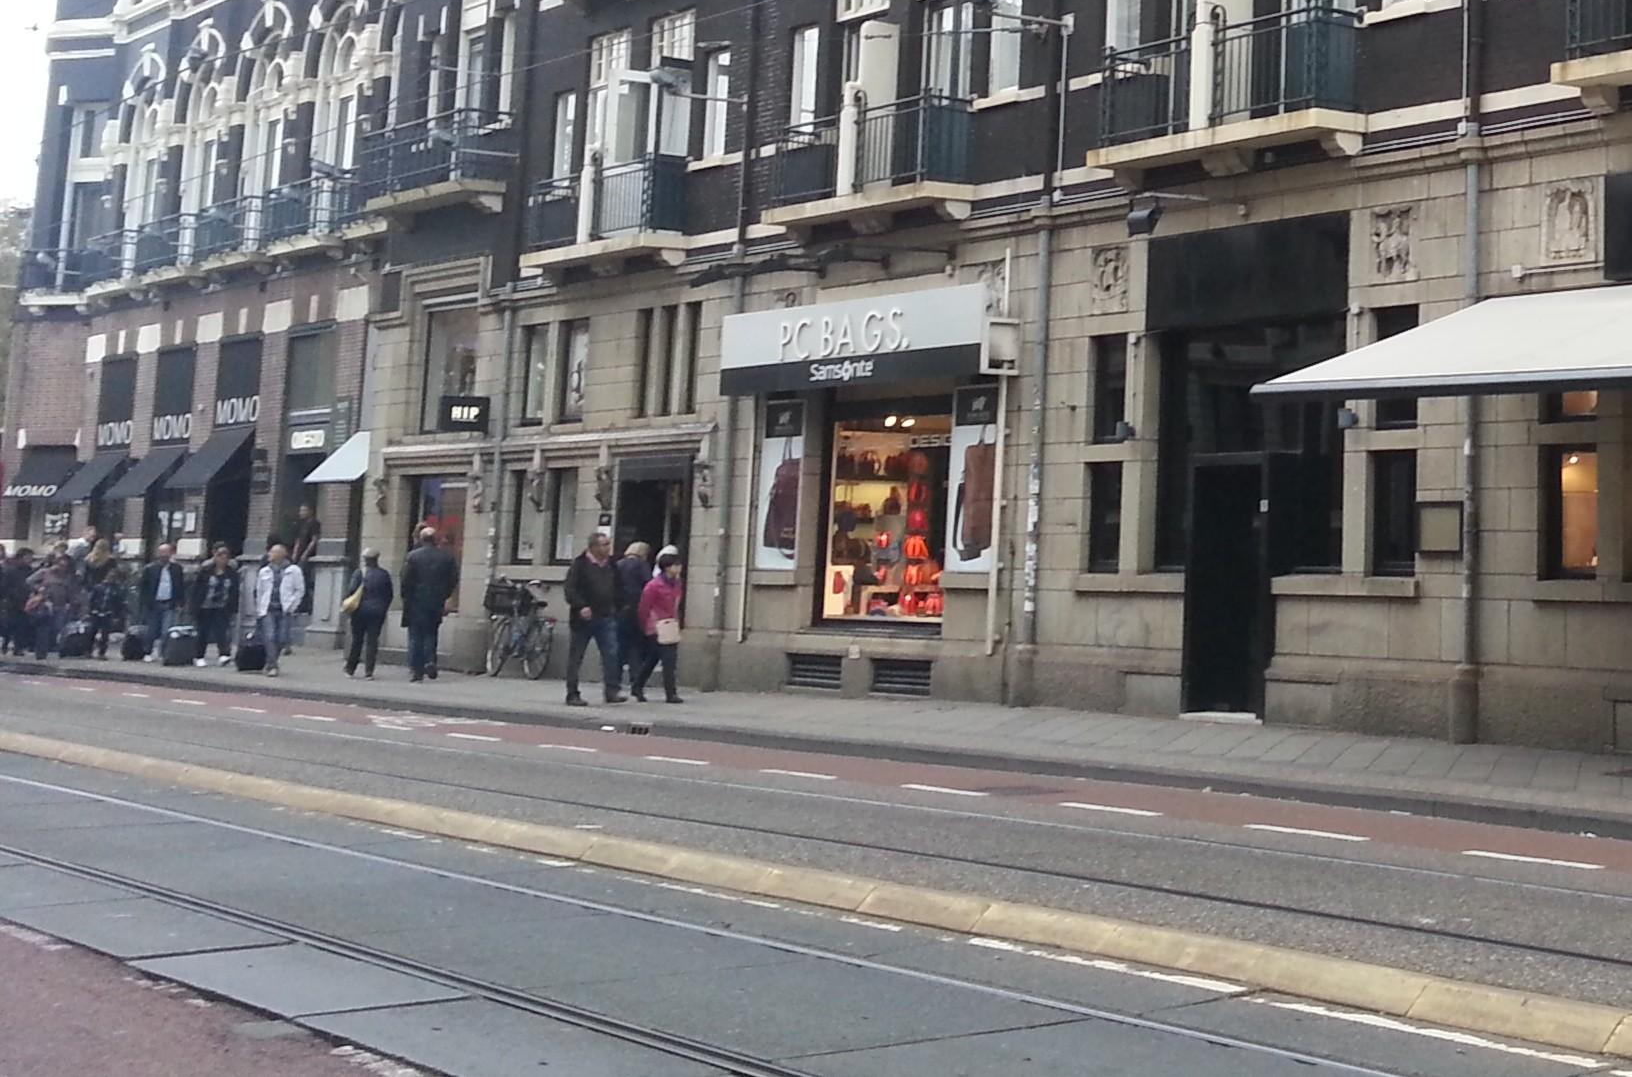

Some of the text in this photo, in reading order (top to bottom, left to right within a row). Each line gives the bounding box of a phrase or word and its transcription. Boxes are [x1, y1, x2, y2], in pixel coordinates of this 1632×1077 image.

[778, 317, 811, 362] PC
[214, 395, 260, 425] MOMO
[450, 405, 480, 420] HIP
[98, 420, 132, 446] MOMO
[153, 413, 192, 440] MOMO
[3, 484, 58, 498] MOMO
